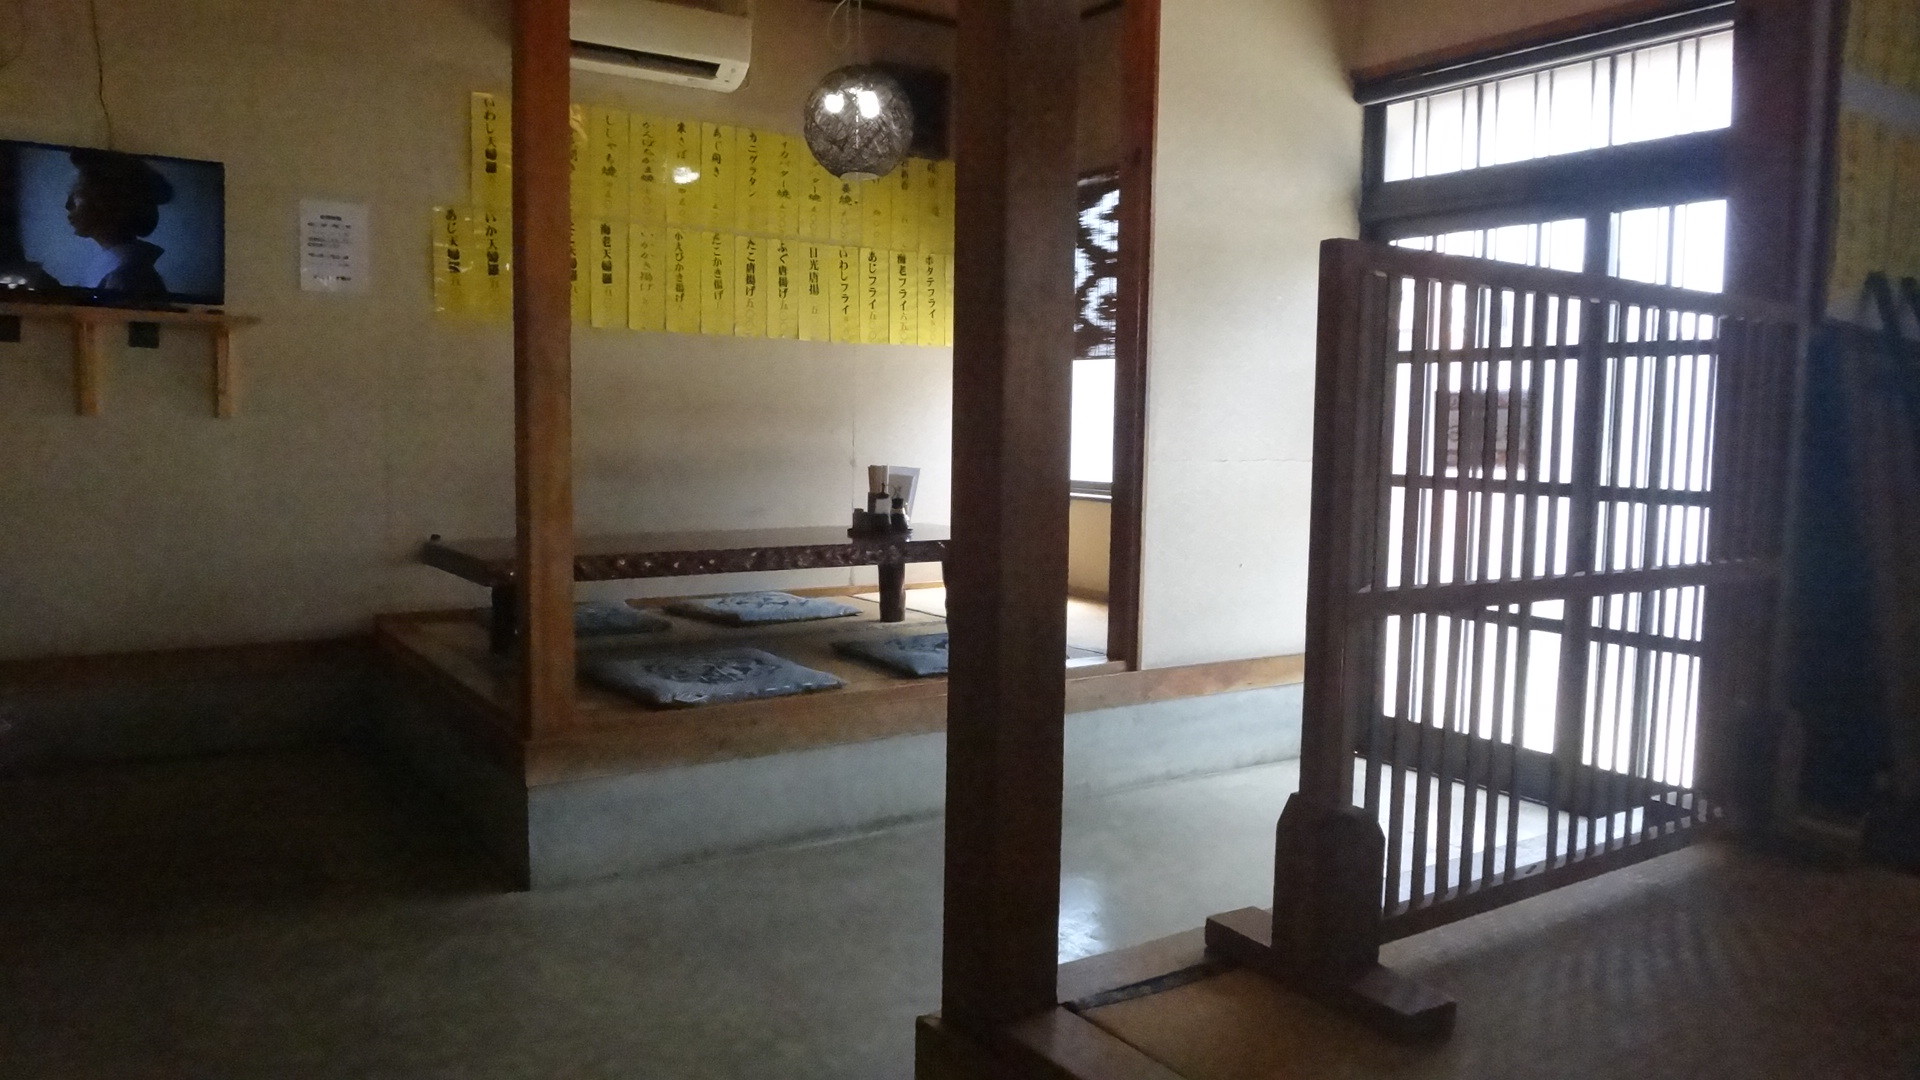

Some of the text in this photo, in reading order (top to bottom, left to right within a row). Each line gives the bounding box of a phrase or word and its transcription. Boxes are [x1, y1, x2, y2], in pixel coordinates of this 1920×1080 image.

[838, 249, 850, 316] いわしフライ
[867, 250, 878, 311] あじフライ
[896, 252, 908, 312] 海老フライ
[924, 254, 937, 320] ホタテフライ
